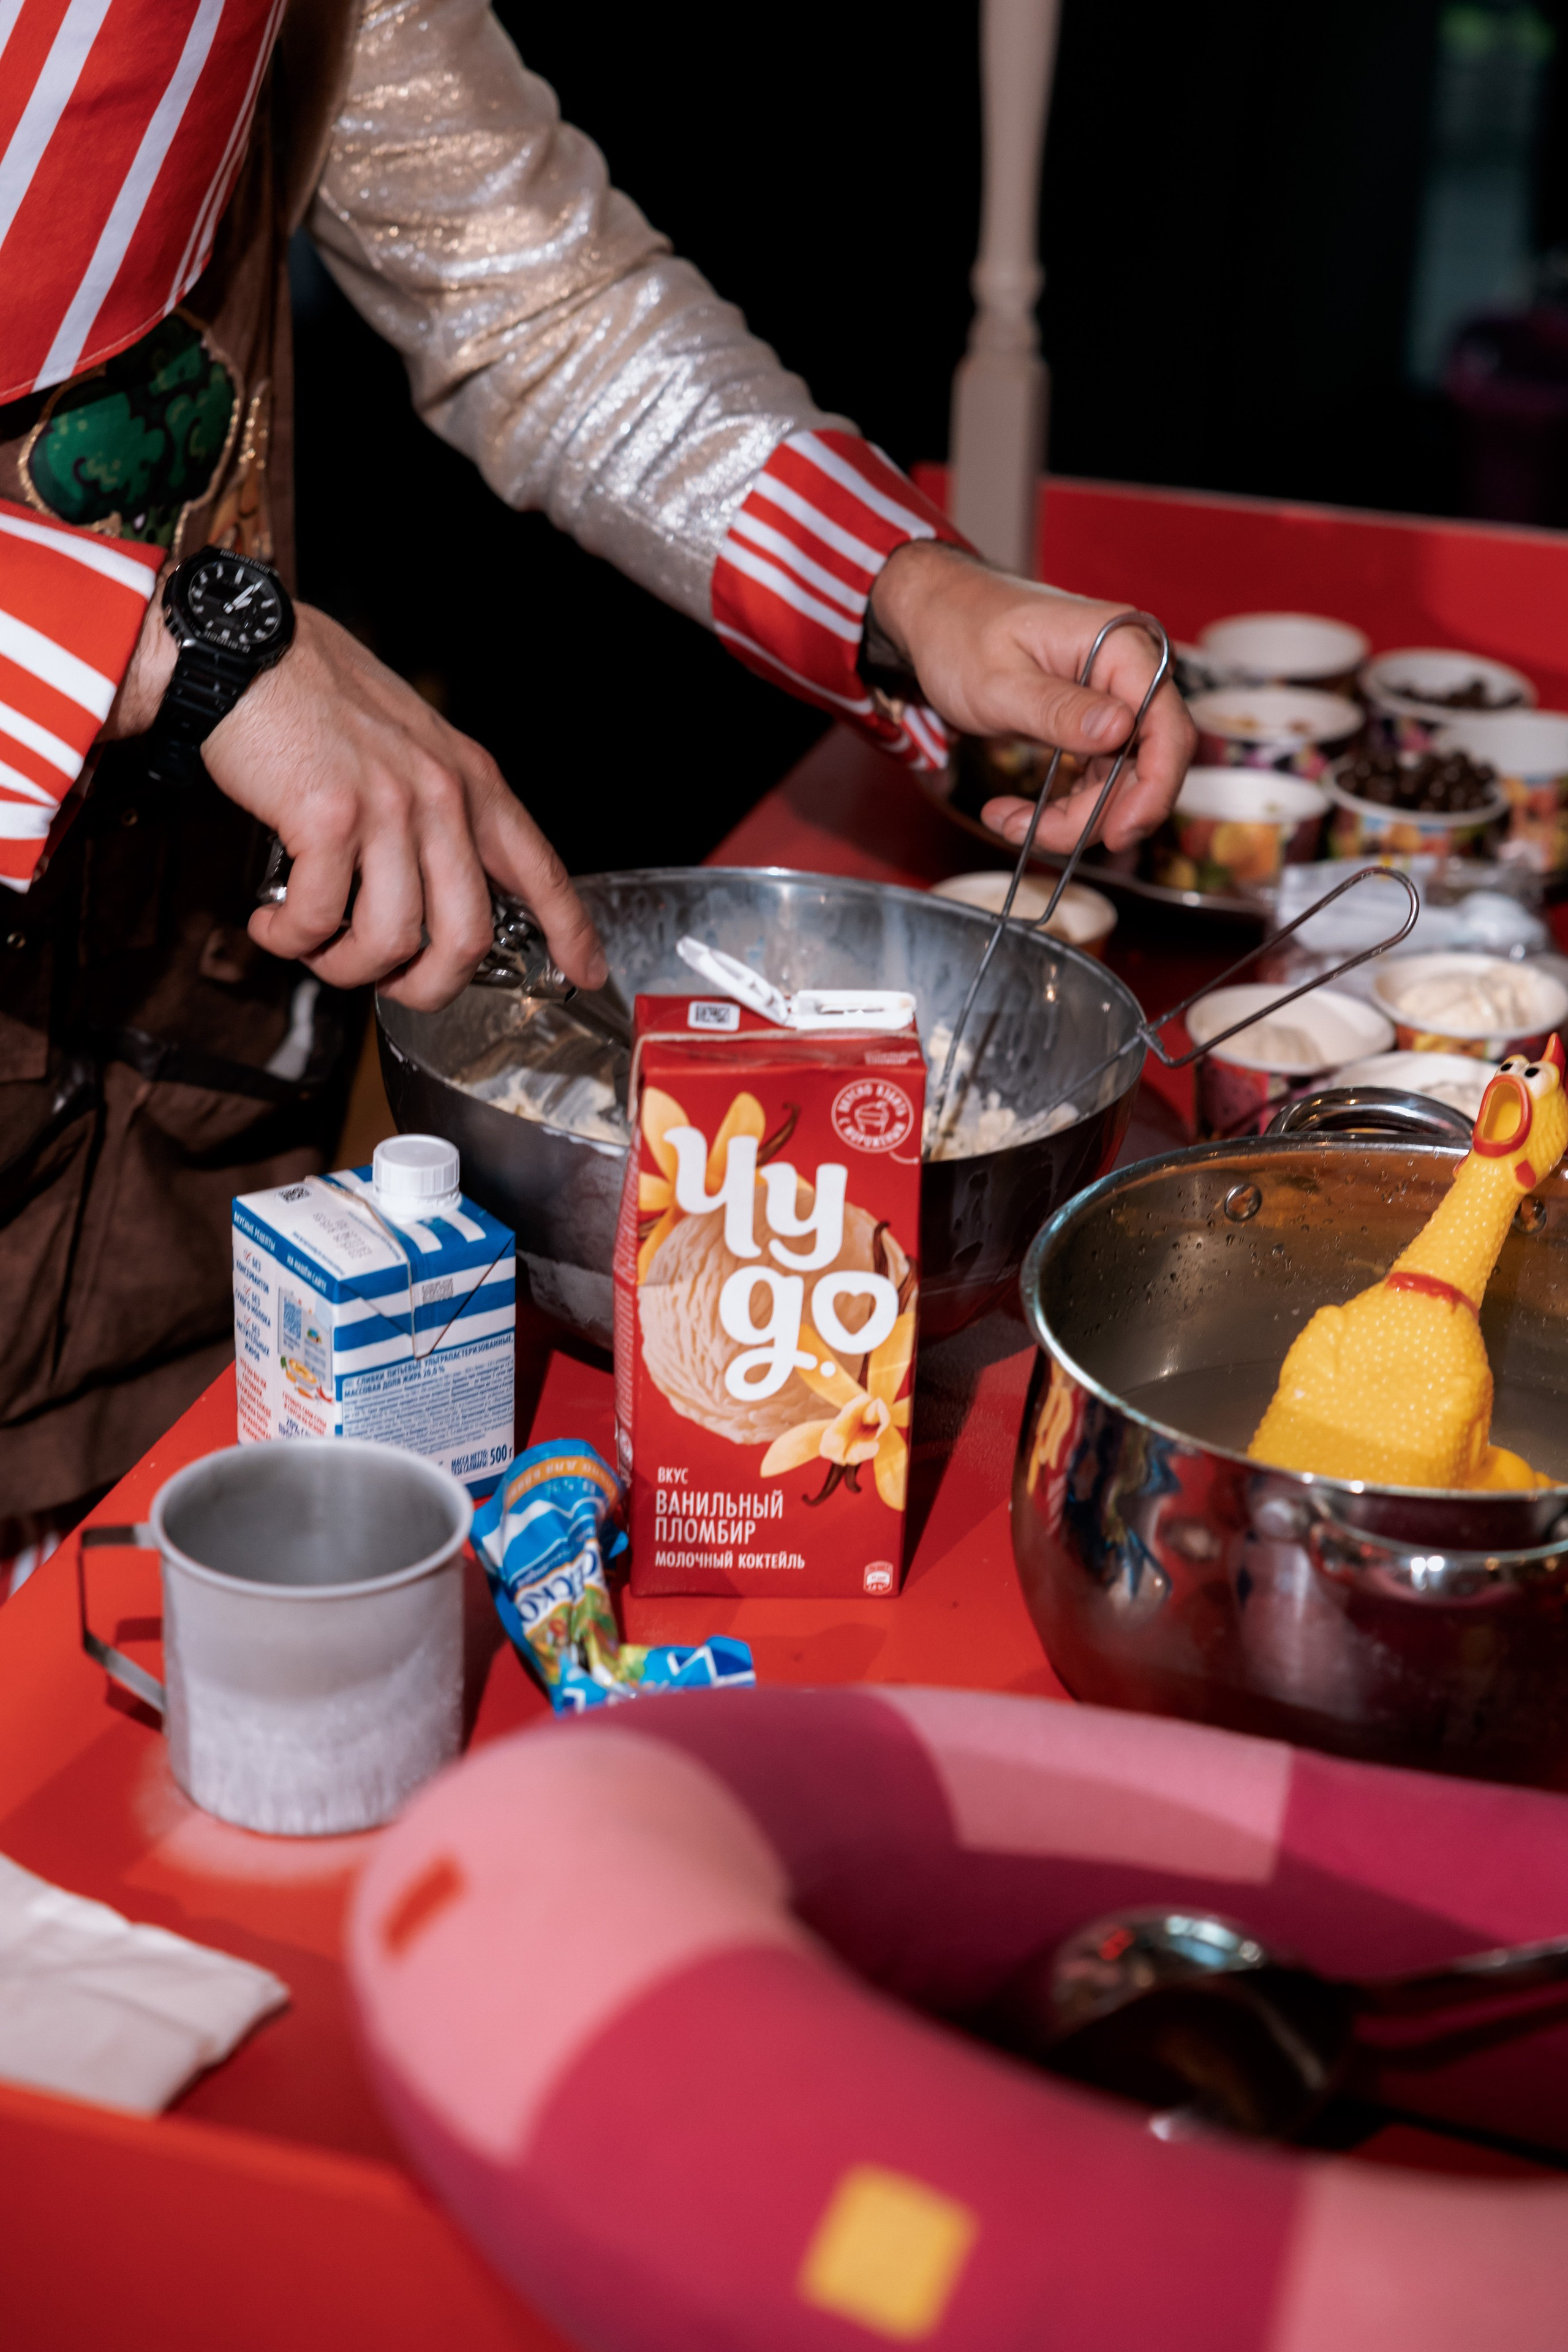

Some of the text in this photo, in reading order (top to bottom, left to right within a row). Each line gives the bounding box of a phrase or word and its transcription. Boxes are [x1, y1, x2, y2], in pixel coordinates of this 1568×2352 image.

[357, 1370, 384, 1385] СЛИВКИ
[344, 1382, 381, 1398] МАССОВАЯ
[490, 1443, 507, 1466] 500
[658, 1466, 688, 1485] ВКУС
[656, 1489, 784, 1519] ВАНИЛЬНЫЙ
[655, 1517, 756, 1545] ПЛОМБИР
[655, 1550, 805, 1570] МОЛОЧНЫЙ КОКТЕЙЛЬ
